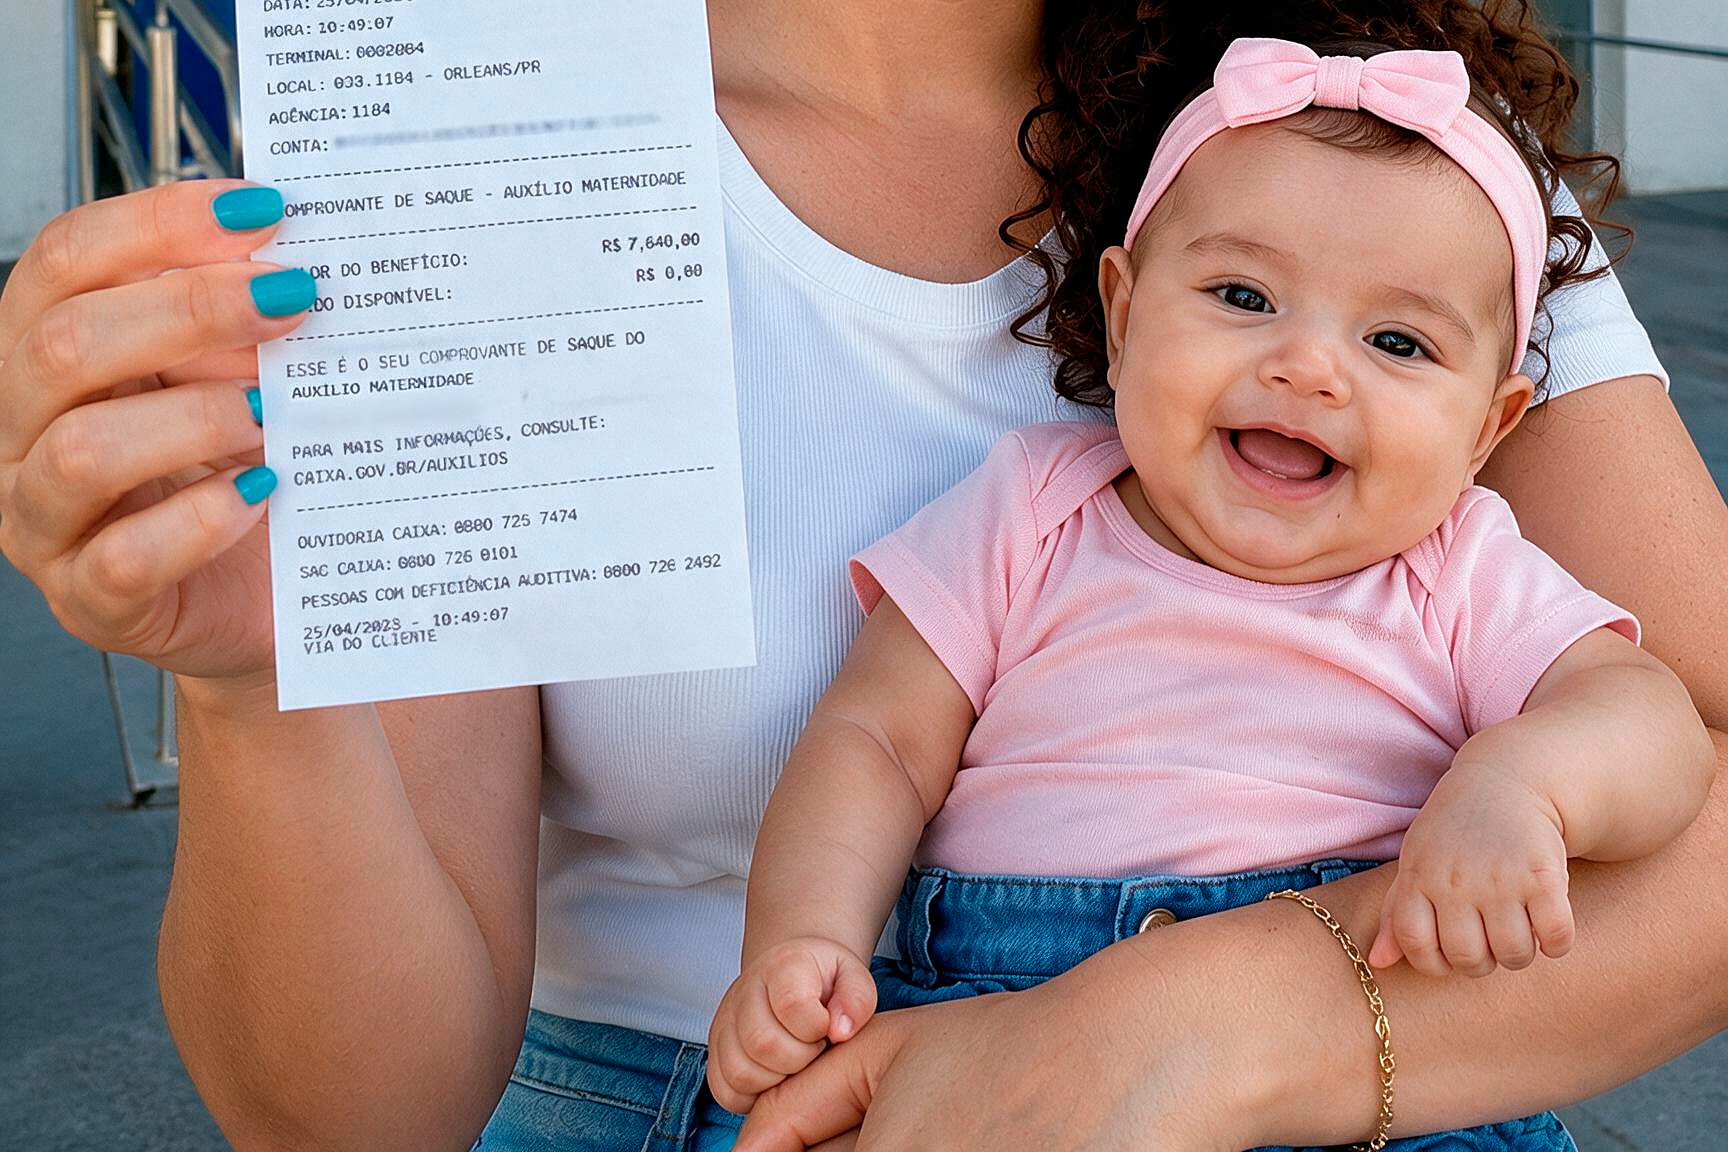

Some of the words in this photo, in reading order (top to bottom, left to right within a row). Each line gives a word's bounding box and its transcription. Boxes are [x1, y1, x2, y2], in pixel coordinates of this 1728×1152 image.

[263, 23, 311, 39] HORA:
[264, 47, 351, 67] TERMINAL:
[266, 78, 325, 96] LOCAL:
[442, 59, 542, 81] ORLEANS/PR
[351, 101, 391, 119] 1184
[269, 138, 329, 156] CONTA:
[284, 194, 385, 218] OMPROVANTE
[393, 192, 415, 208] DE
[423, 187, 474, 206] SAQUE
[502, 179, 573, 199] AUXÍLIO
[580, 170, 687, 193] MATERNIDADE
[339, 261, 362, 278] DO
[369, 252, 468, 275] BENEFÍCIO:
[601, 236, 622, 254] R$
[343, 286, 452, 310] DISPONÍVEL:
[635, 266, 656, 283] R$
[664, 262, 703, 282] 0,00
[285, 359, 329, 379] ESSE
[337, 354, 348, 374] É
[357, 356, 369, 372] O
[378, 353, 410, 370] SEU
[418, 341, 527, 365] COMPROVANTE
[536, 338, 557, 354] DE
[566, 332, 617, 352] SAQUE
[624, 330, 646, 346] DO
[368, 371, 475, 393] MATERNIDADE
[291, 442, 334, 460] PARA
[342, 438, 384, 456] MAIS
[519, 414, 606, 438] CONSULTE:
[293, 450, 509, 487] CAIXA.GOV.BR/AUXILIOS
[296, 528, 385, 550] OUVIDORIA
[391, 523, 447, 541] CAIXA:
[501, 513, 531, 530] 725
[538, 507, 578, 525] 7474
[298, 563, 329, 580] SAC
[336, 557, 392, 576] CAIXA:
[444, 548, 473, 566] 726
[479, 545, 519, 562] 0101
[301, 589, 368, 610] PESSOAS
[374, 585, 405, 602] COM
[411, 574, 511, 599] DEFICIÊNCIA
[517, 567, 597, 588] AUDITIVA:
[648, 557, 677, 575] 726
[683, 552, 722, 571] 2492
[432, 605, 509, 627] 10:49:07
[303, 639, 335, 655] VIA
[341, 636, 363, 651] DO
[370, 628, 438, 649] CLIENTE
